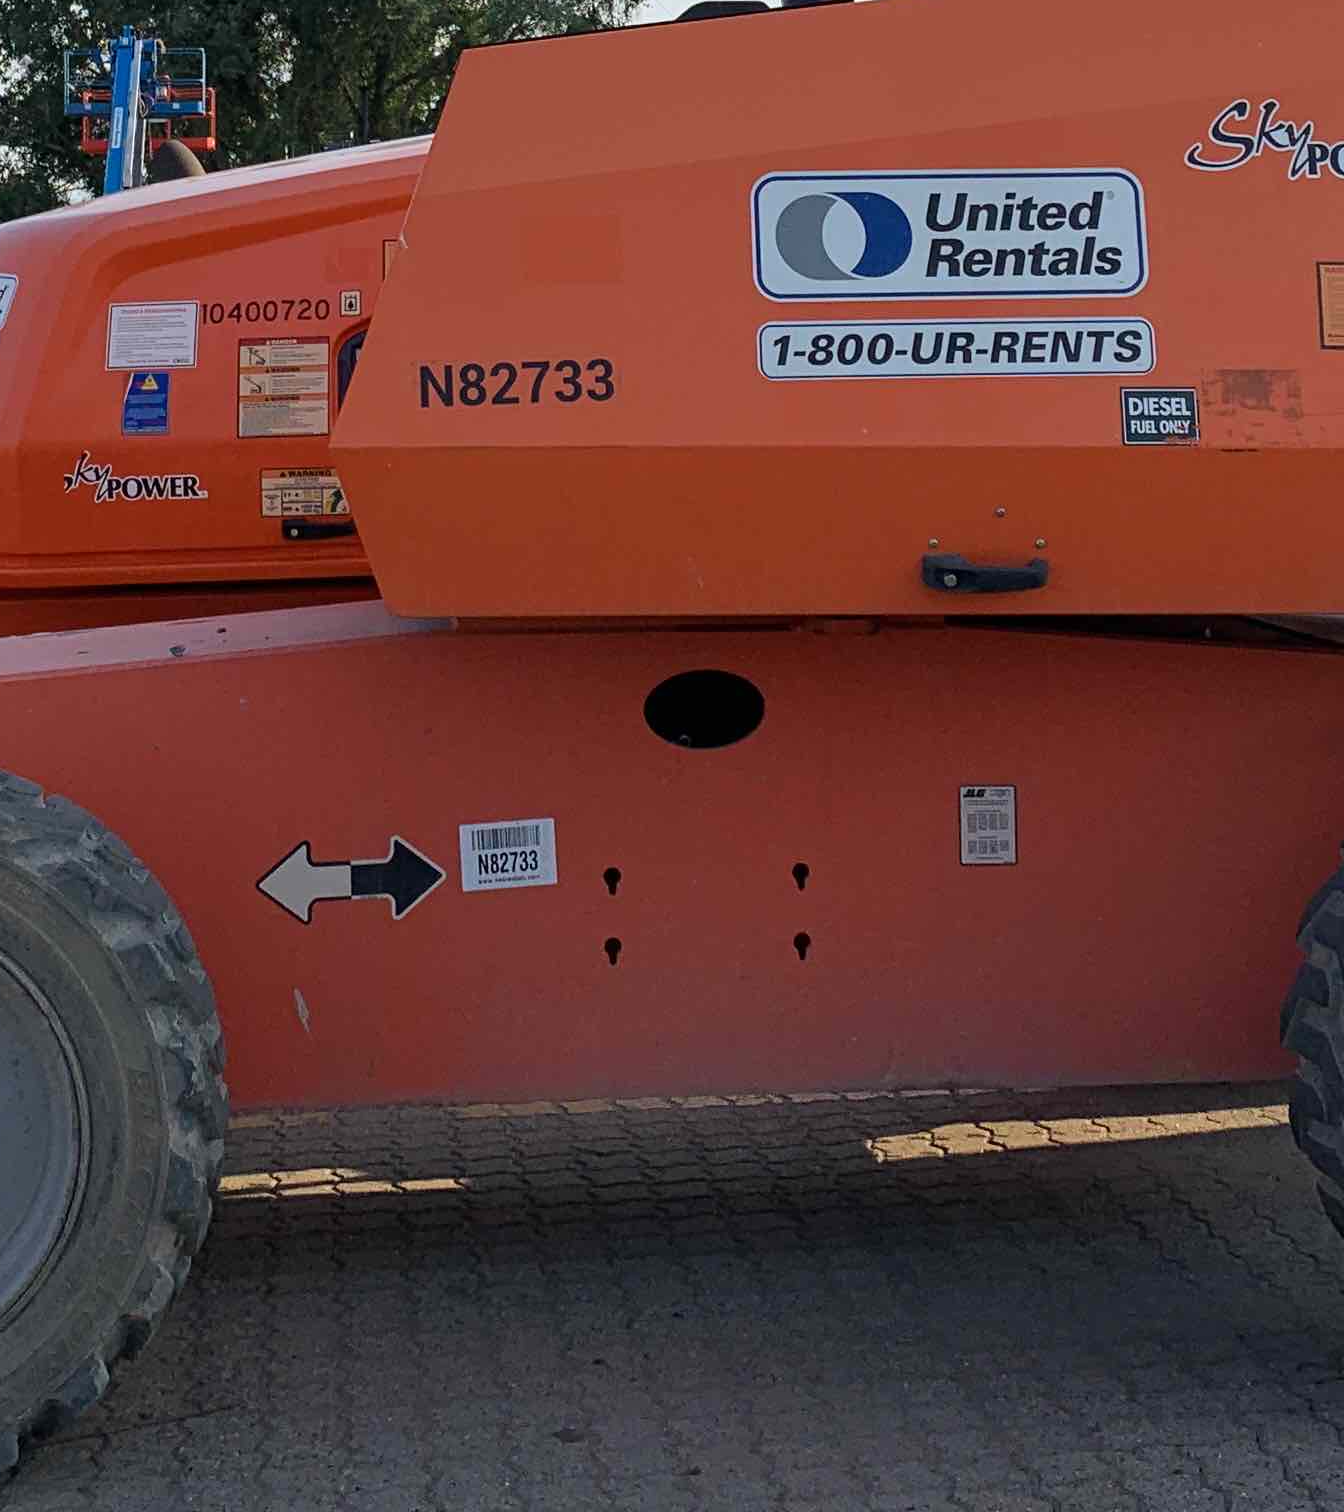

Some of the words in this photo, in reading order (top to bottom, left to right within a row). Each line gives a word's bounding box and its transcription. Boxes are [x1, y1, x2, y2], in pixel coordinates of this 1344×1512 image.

[926, 191, 1104, 232] United
[925, 237, 1123, 278] Rentals
[201, 298, 331, 324] 10400720
[772, 330, 1143, 367] 1-800-UR-RENTS
[419, 358, 616, 409] N82733
[1128, 397, 1192, 417] DIESEL
[1130, 420, 1156, 434] FUEL
[1159, 420, 1191, 435] ONLY
[478, 850, 539, 875] N82733
